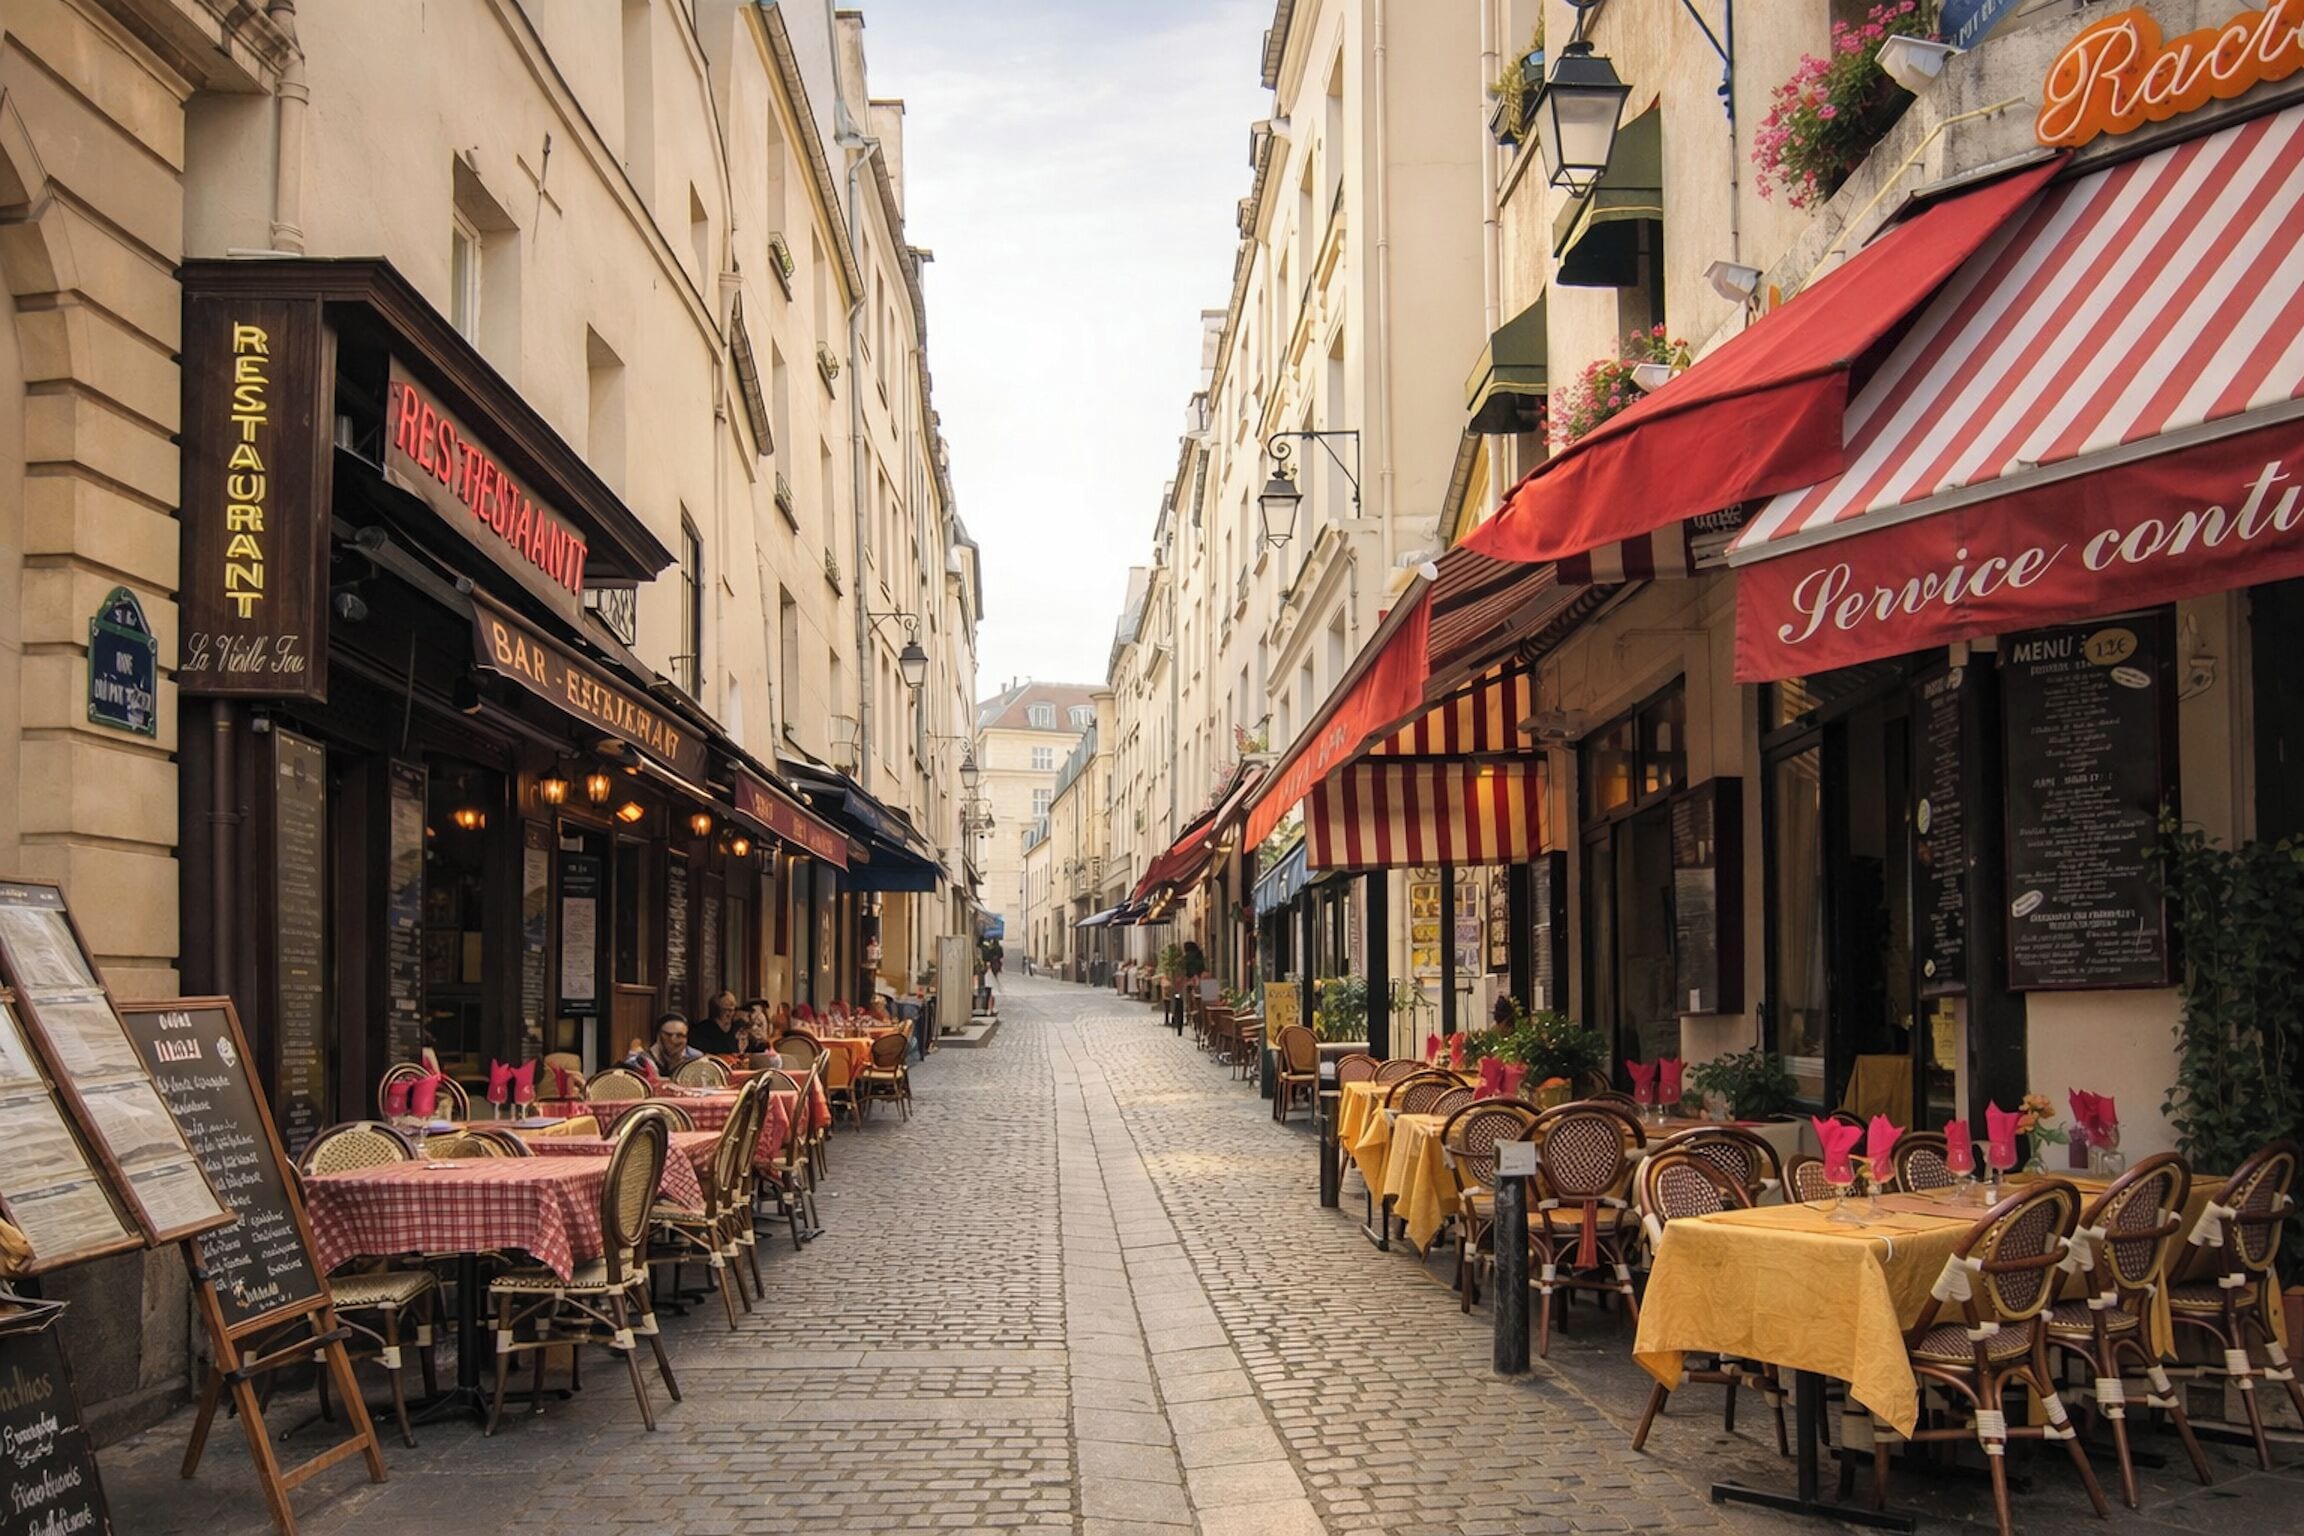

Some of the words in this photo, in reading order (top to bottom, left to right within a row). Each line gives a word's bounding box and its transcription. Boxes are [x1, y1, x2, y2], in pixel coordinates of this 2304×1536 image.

[225, 321, 270, 620] RESTAURANT
[1778, 543, 2068, 645] Service
[493, 621, 549, 688] BAR
[2012, 635, 2074, 664] MENU
